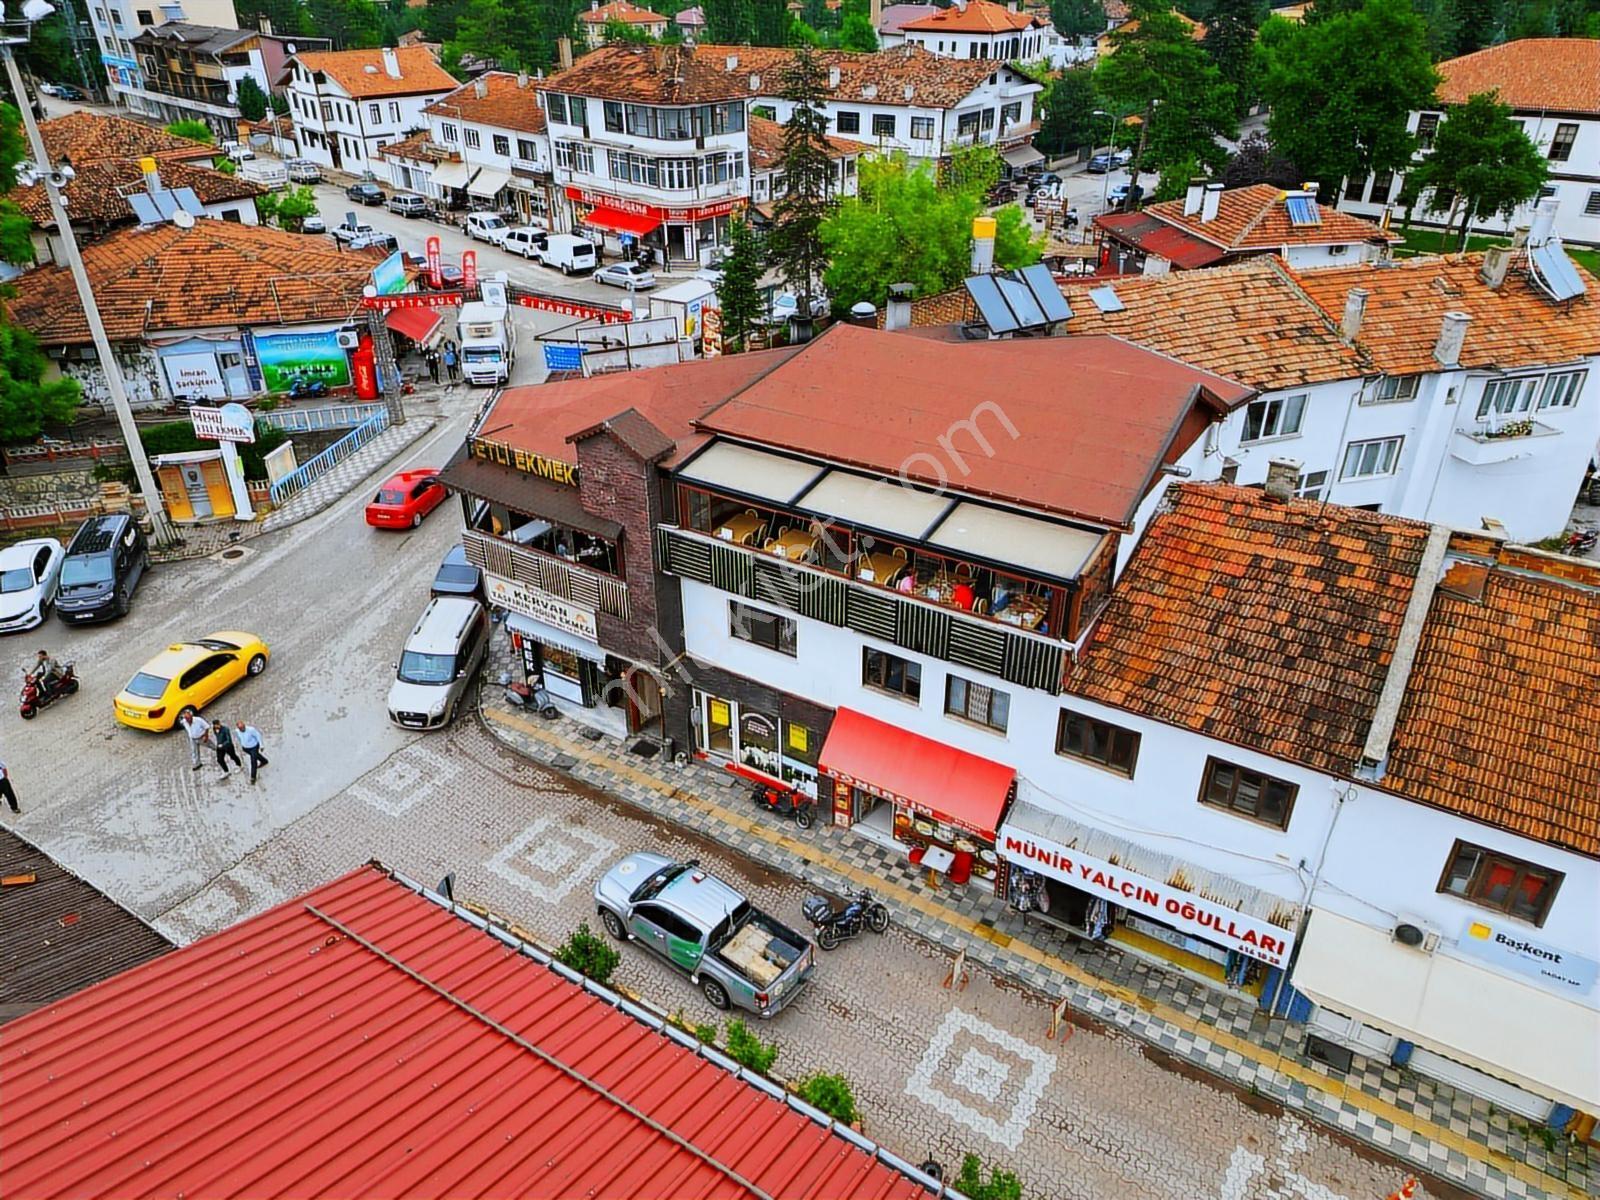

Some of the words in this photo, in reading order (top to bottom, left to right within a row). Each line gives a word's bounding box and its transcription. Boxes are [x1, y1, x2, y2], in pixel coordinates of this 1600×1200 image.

[513, 448, 577, 487] EKMEK
[513, 589, 568, 617] KERVAN
[1006, 836, 1073, 874] MÜNİR
[1080, 864, 1160, 907] YALÇIN
[1165, 899, 1286, 956] OĞULLARI
[1495, 933, 1563, 964] Başkent
